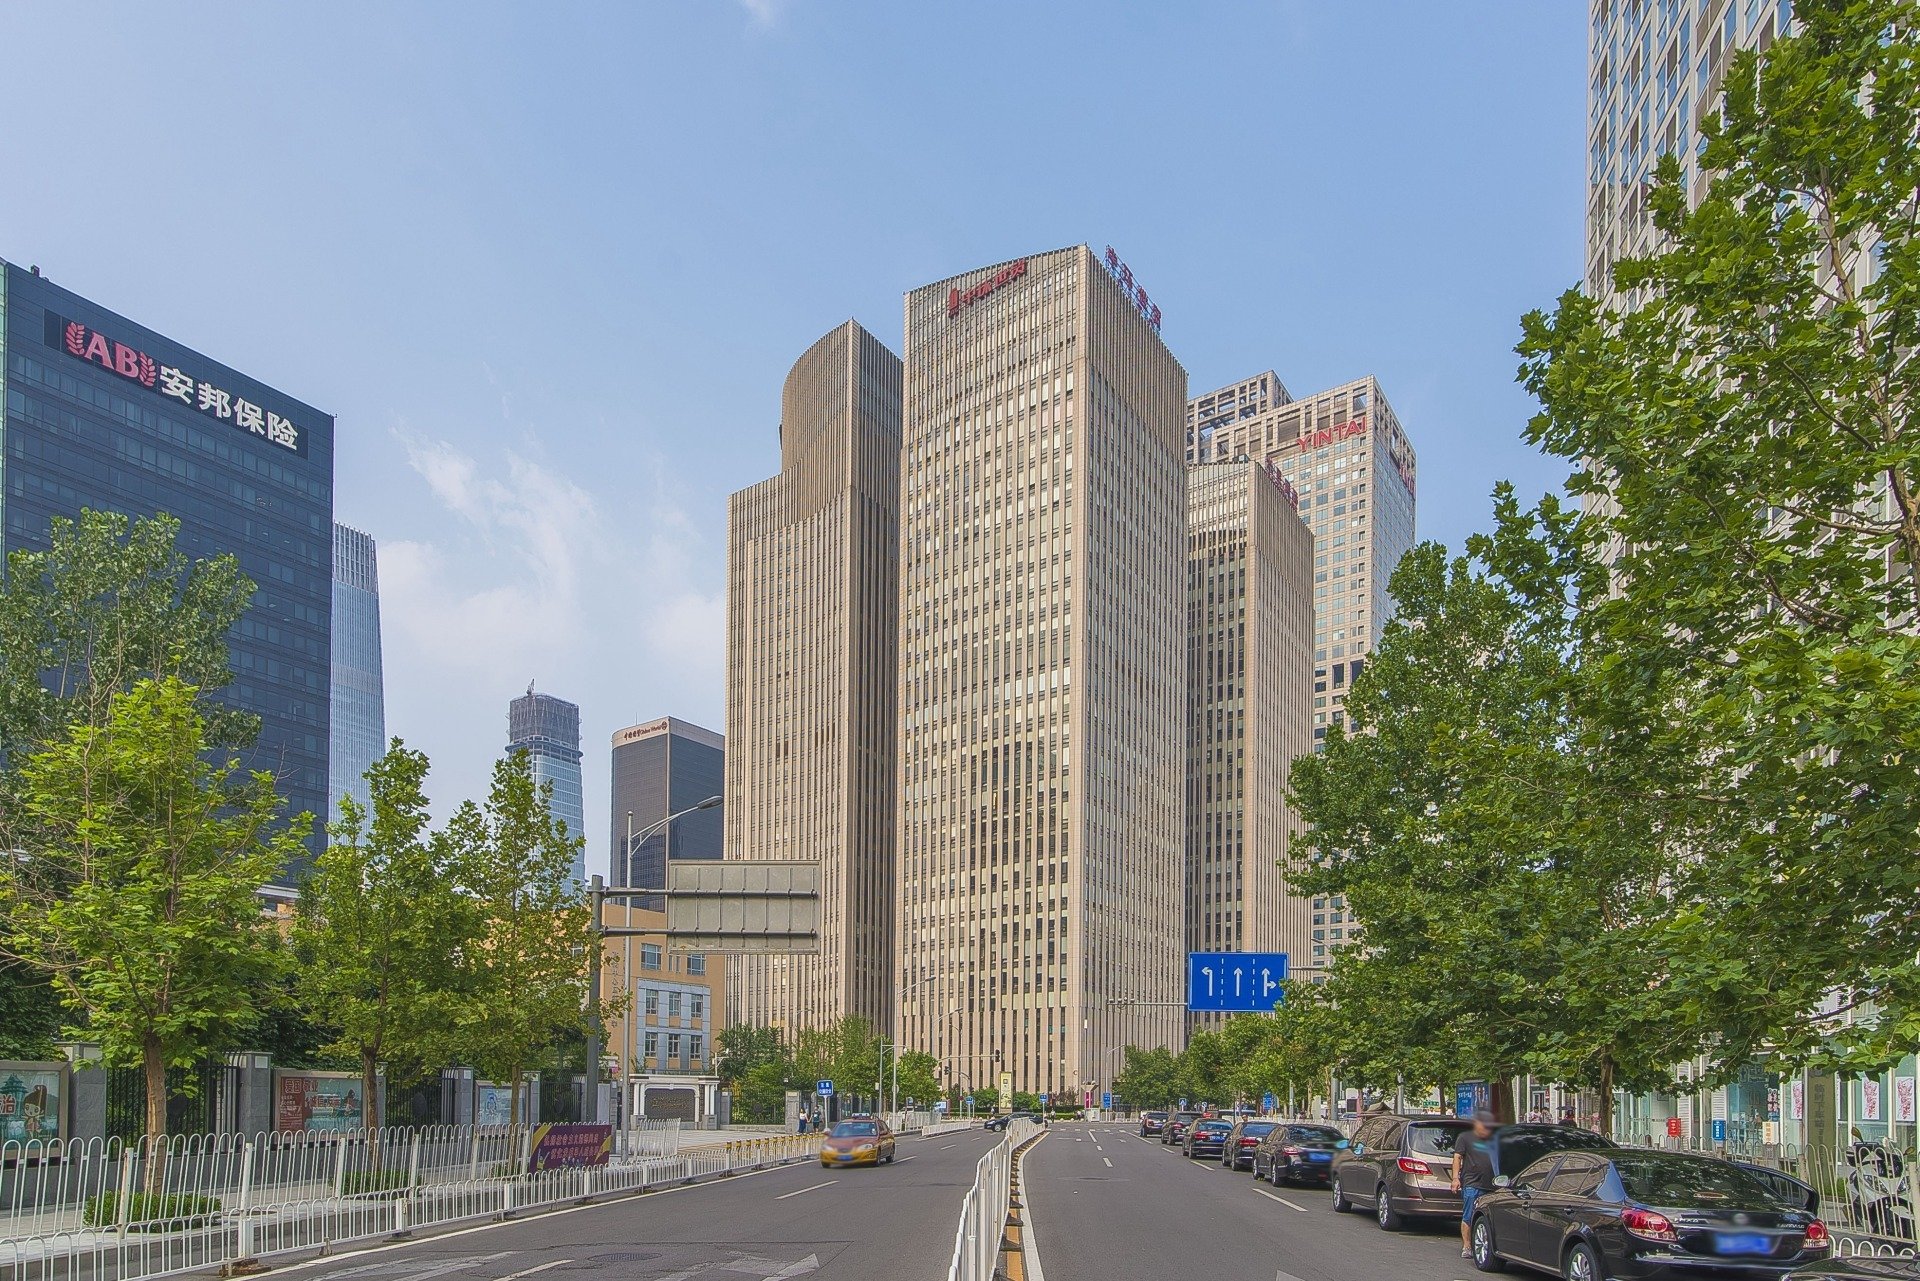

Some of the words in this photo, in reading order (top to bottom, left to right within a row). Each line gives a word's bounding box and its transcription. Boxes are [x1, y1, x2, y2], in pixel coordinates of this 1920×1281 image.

[84, 331, 139, 379] AB
[159, 365, 299, 450] 安邦保险
[1297, 417, 1367, 452] YINTAI
